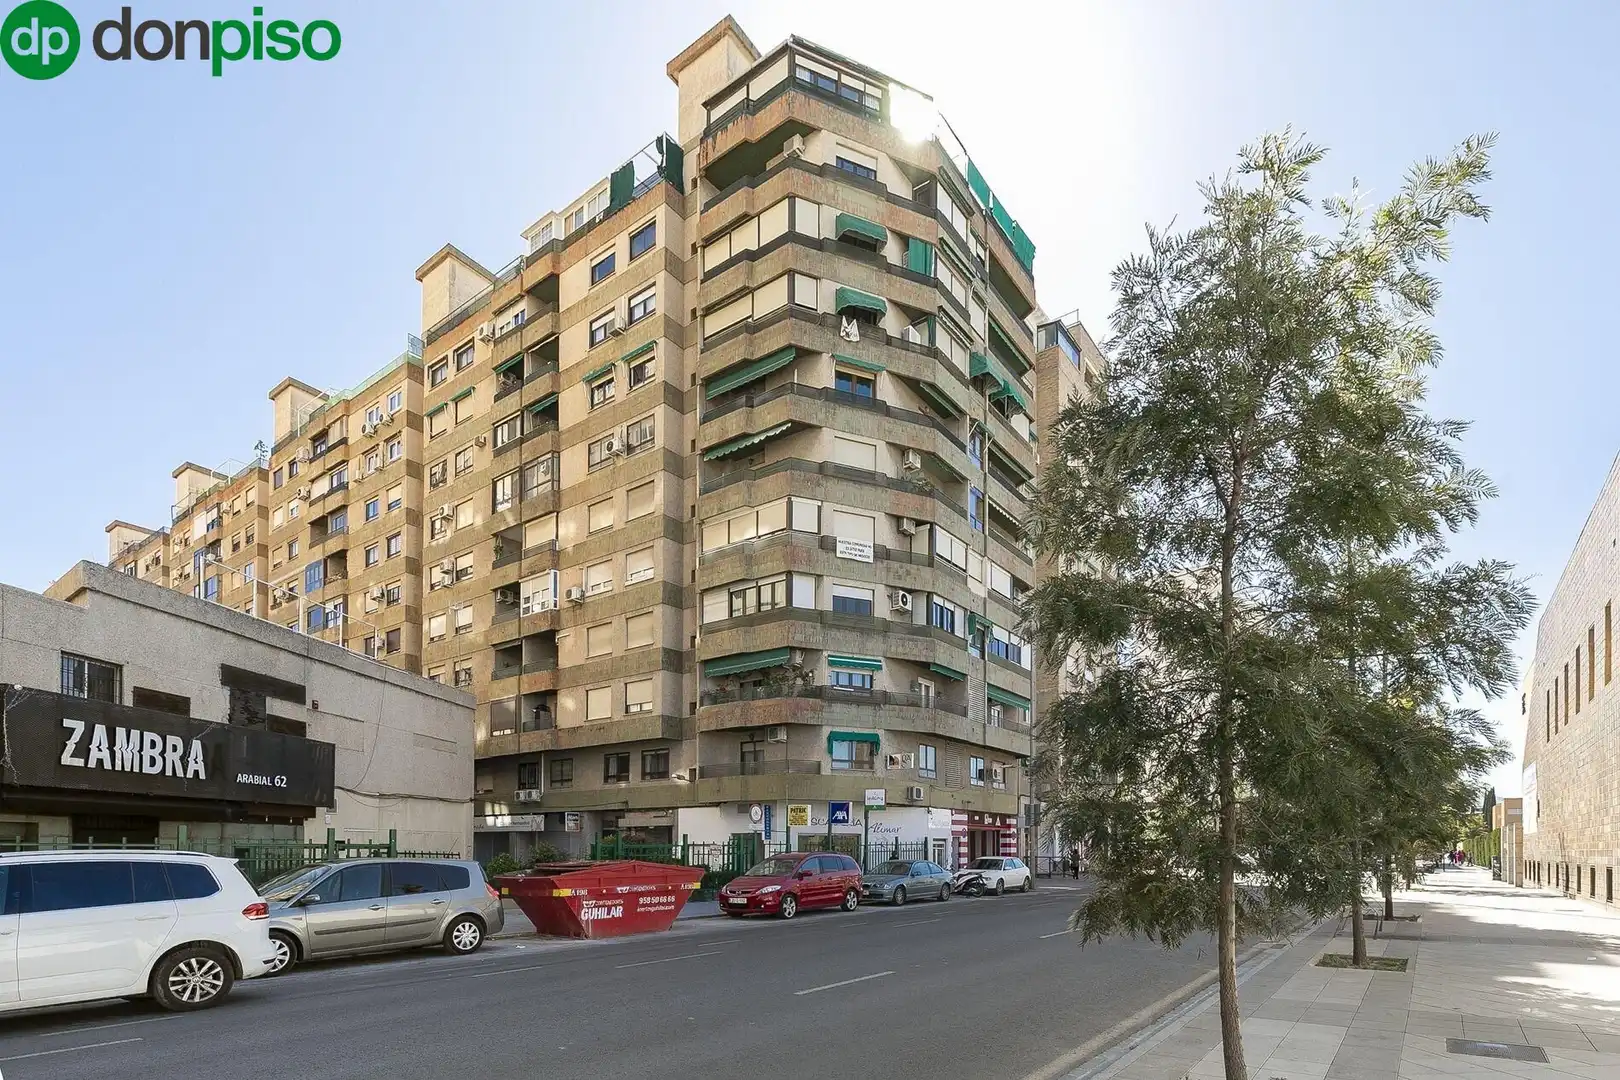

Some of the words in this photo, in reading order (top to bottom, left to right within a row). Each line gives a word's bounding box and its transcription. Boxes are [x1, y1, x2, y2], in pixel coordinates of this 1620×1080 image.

[61, 718, 207, 780] ZAMBRA
[236, 773, 273, 787] ARABIAL
[274, 775, 287, 788] 62
[832, 811, 848, 820] AXA
[581, 905, 624, 921] GUHILAR
